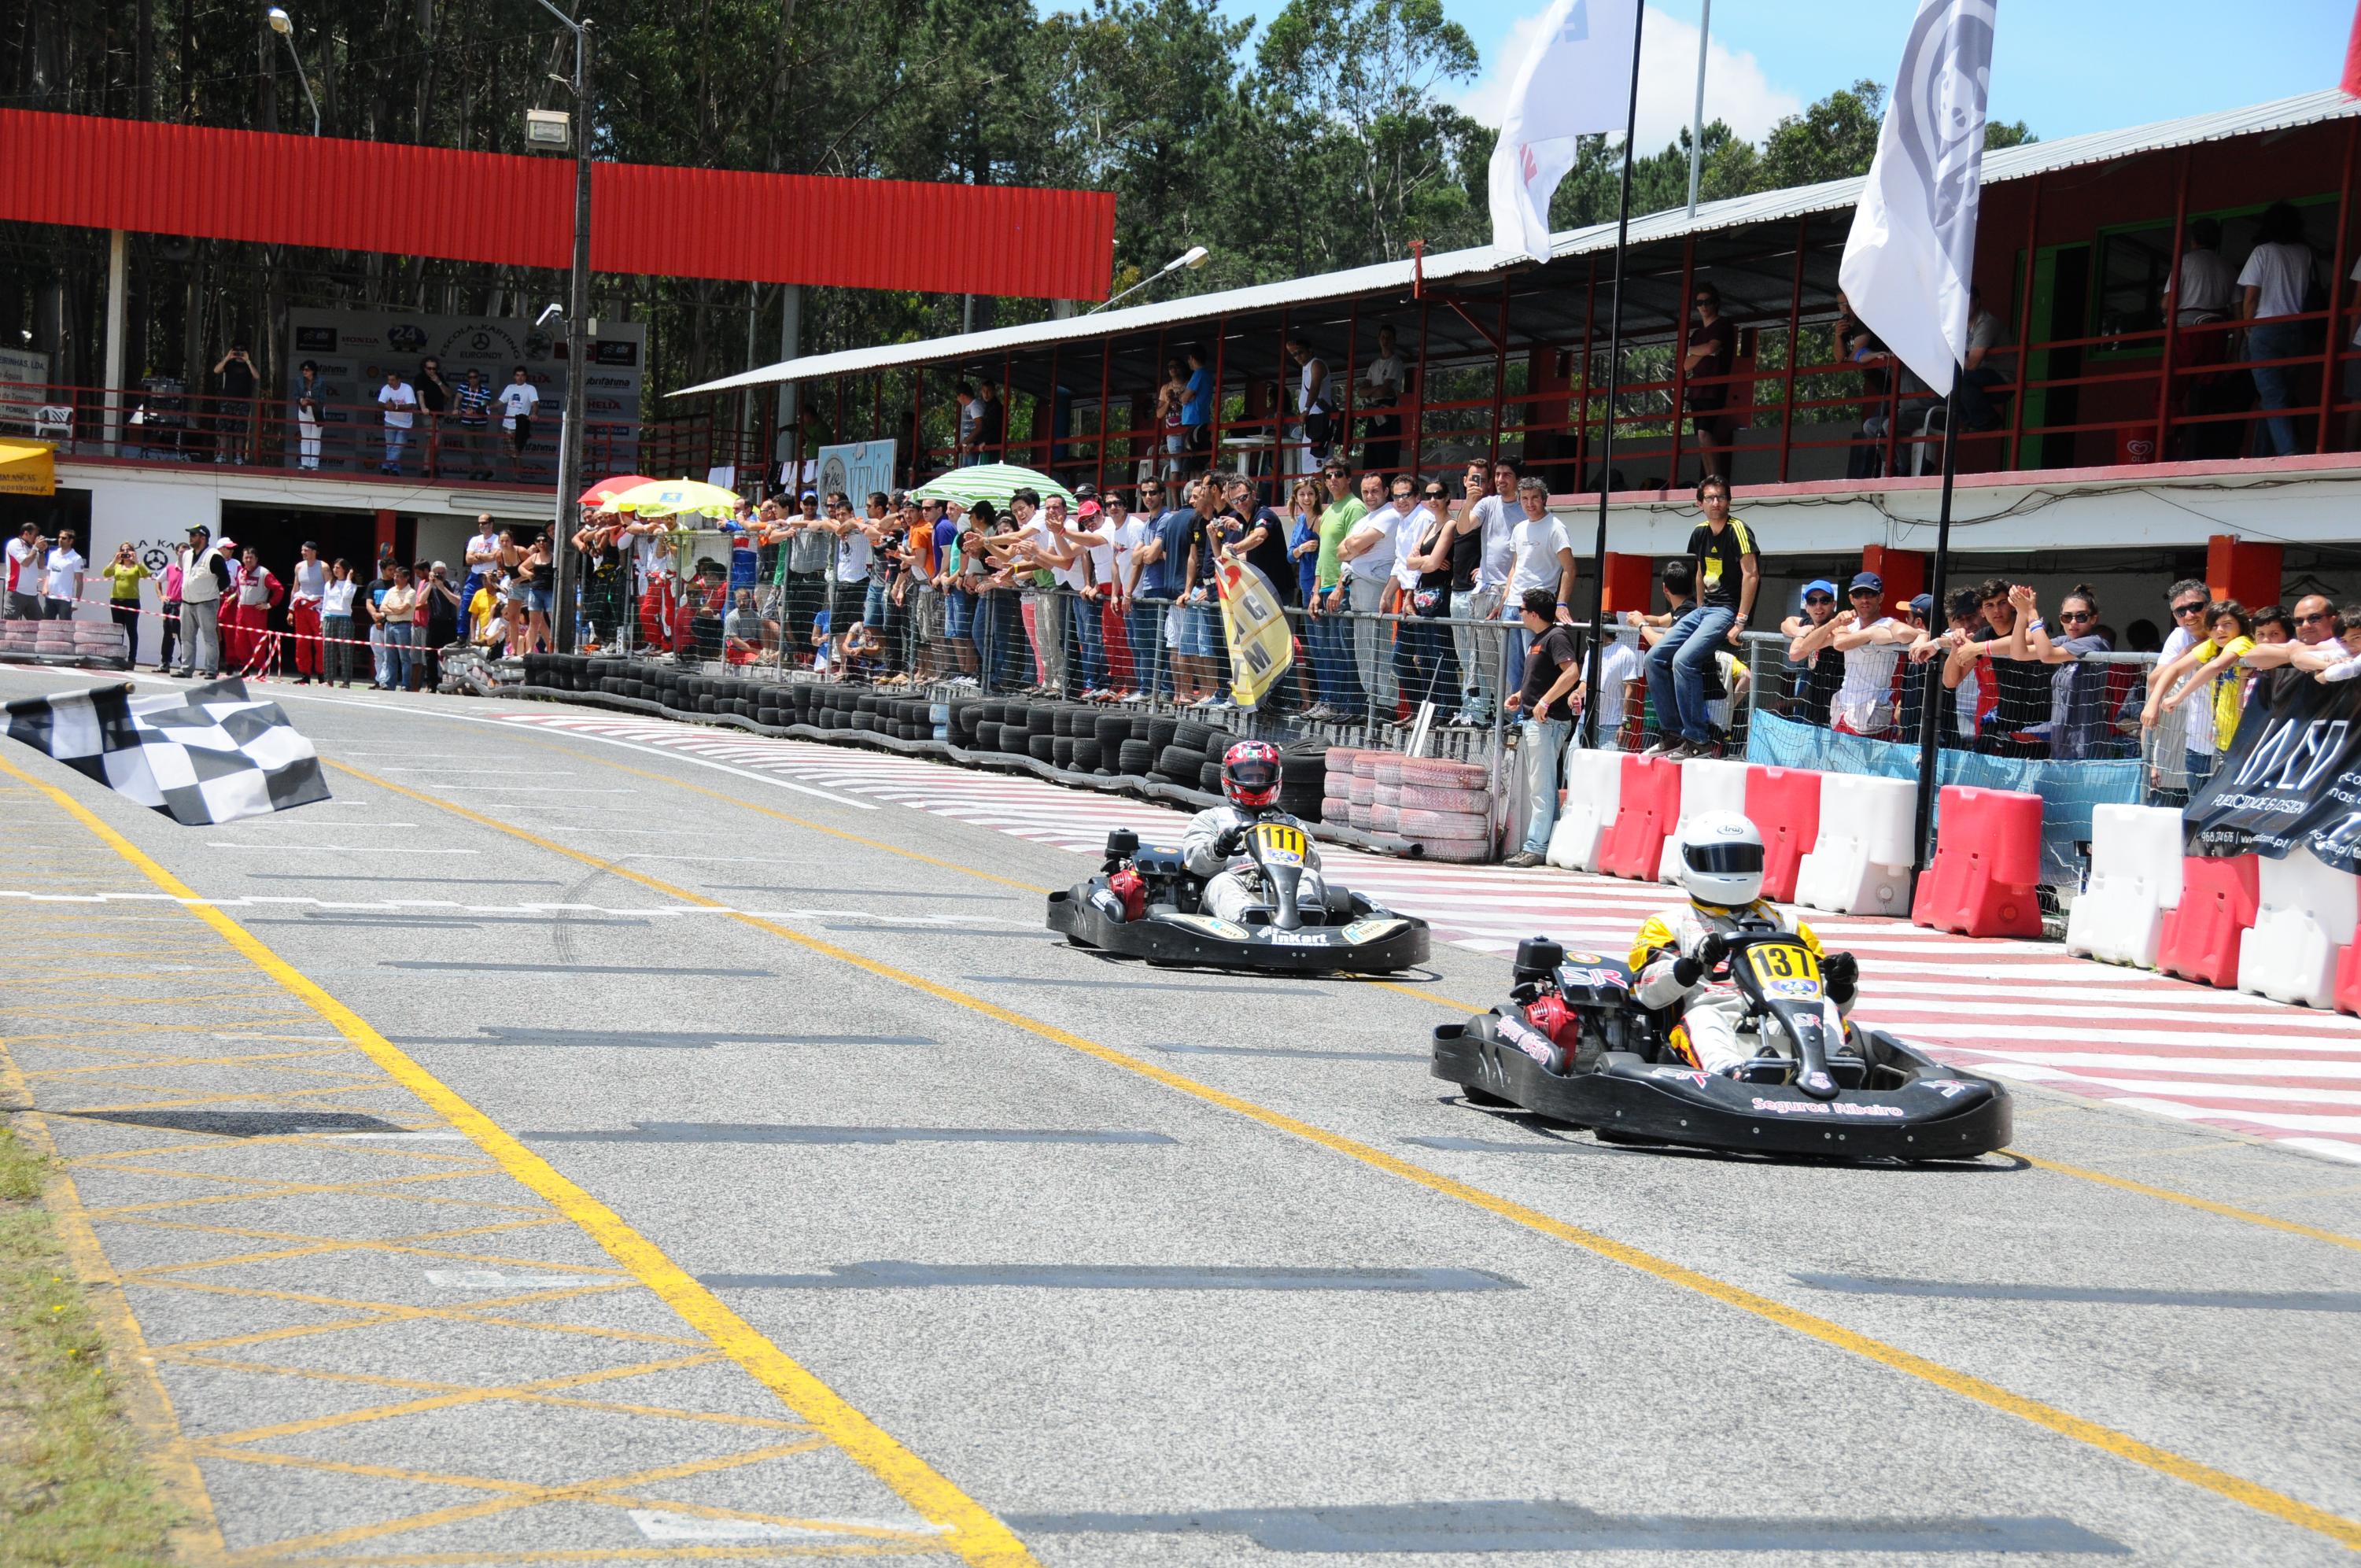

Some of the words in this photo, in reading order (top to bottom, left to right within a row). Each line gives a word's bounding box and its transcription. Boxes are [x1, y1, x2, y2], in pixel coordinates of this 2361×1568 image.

[393, 325, 417, 341] 24
[439, 324, 474, 357] ESCOLA
[481, 323, 521, 359] KARTING
[1262, 827, 1296, 850] 111
[2201, 832, 2215, 843] 968
[1752, 948, 1810, 977] 137
[1751, 1098, 1830, 1113] Seguros
[1832, 1102, 1903, 1116] Ribeiro
